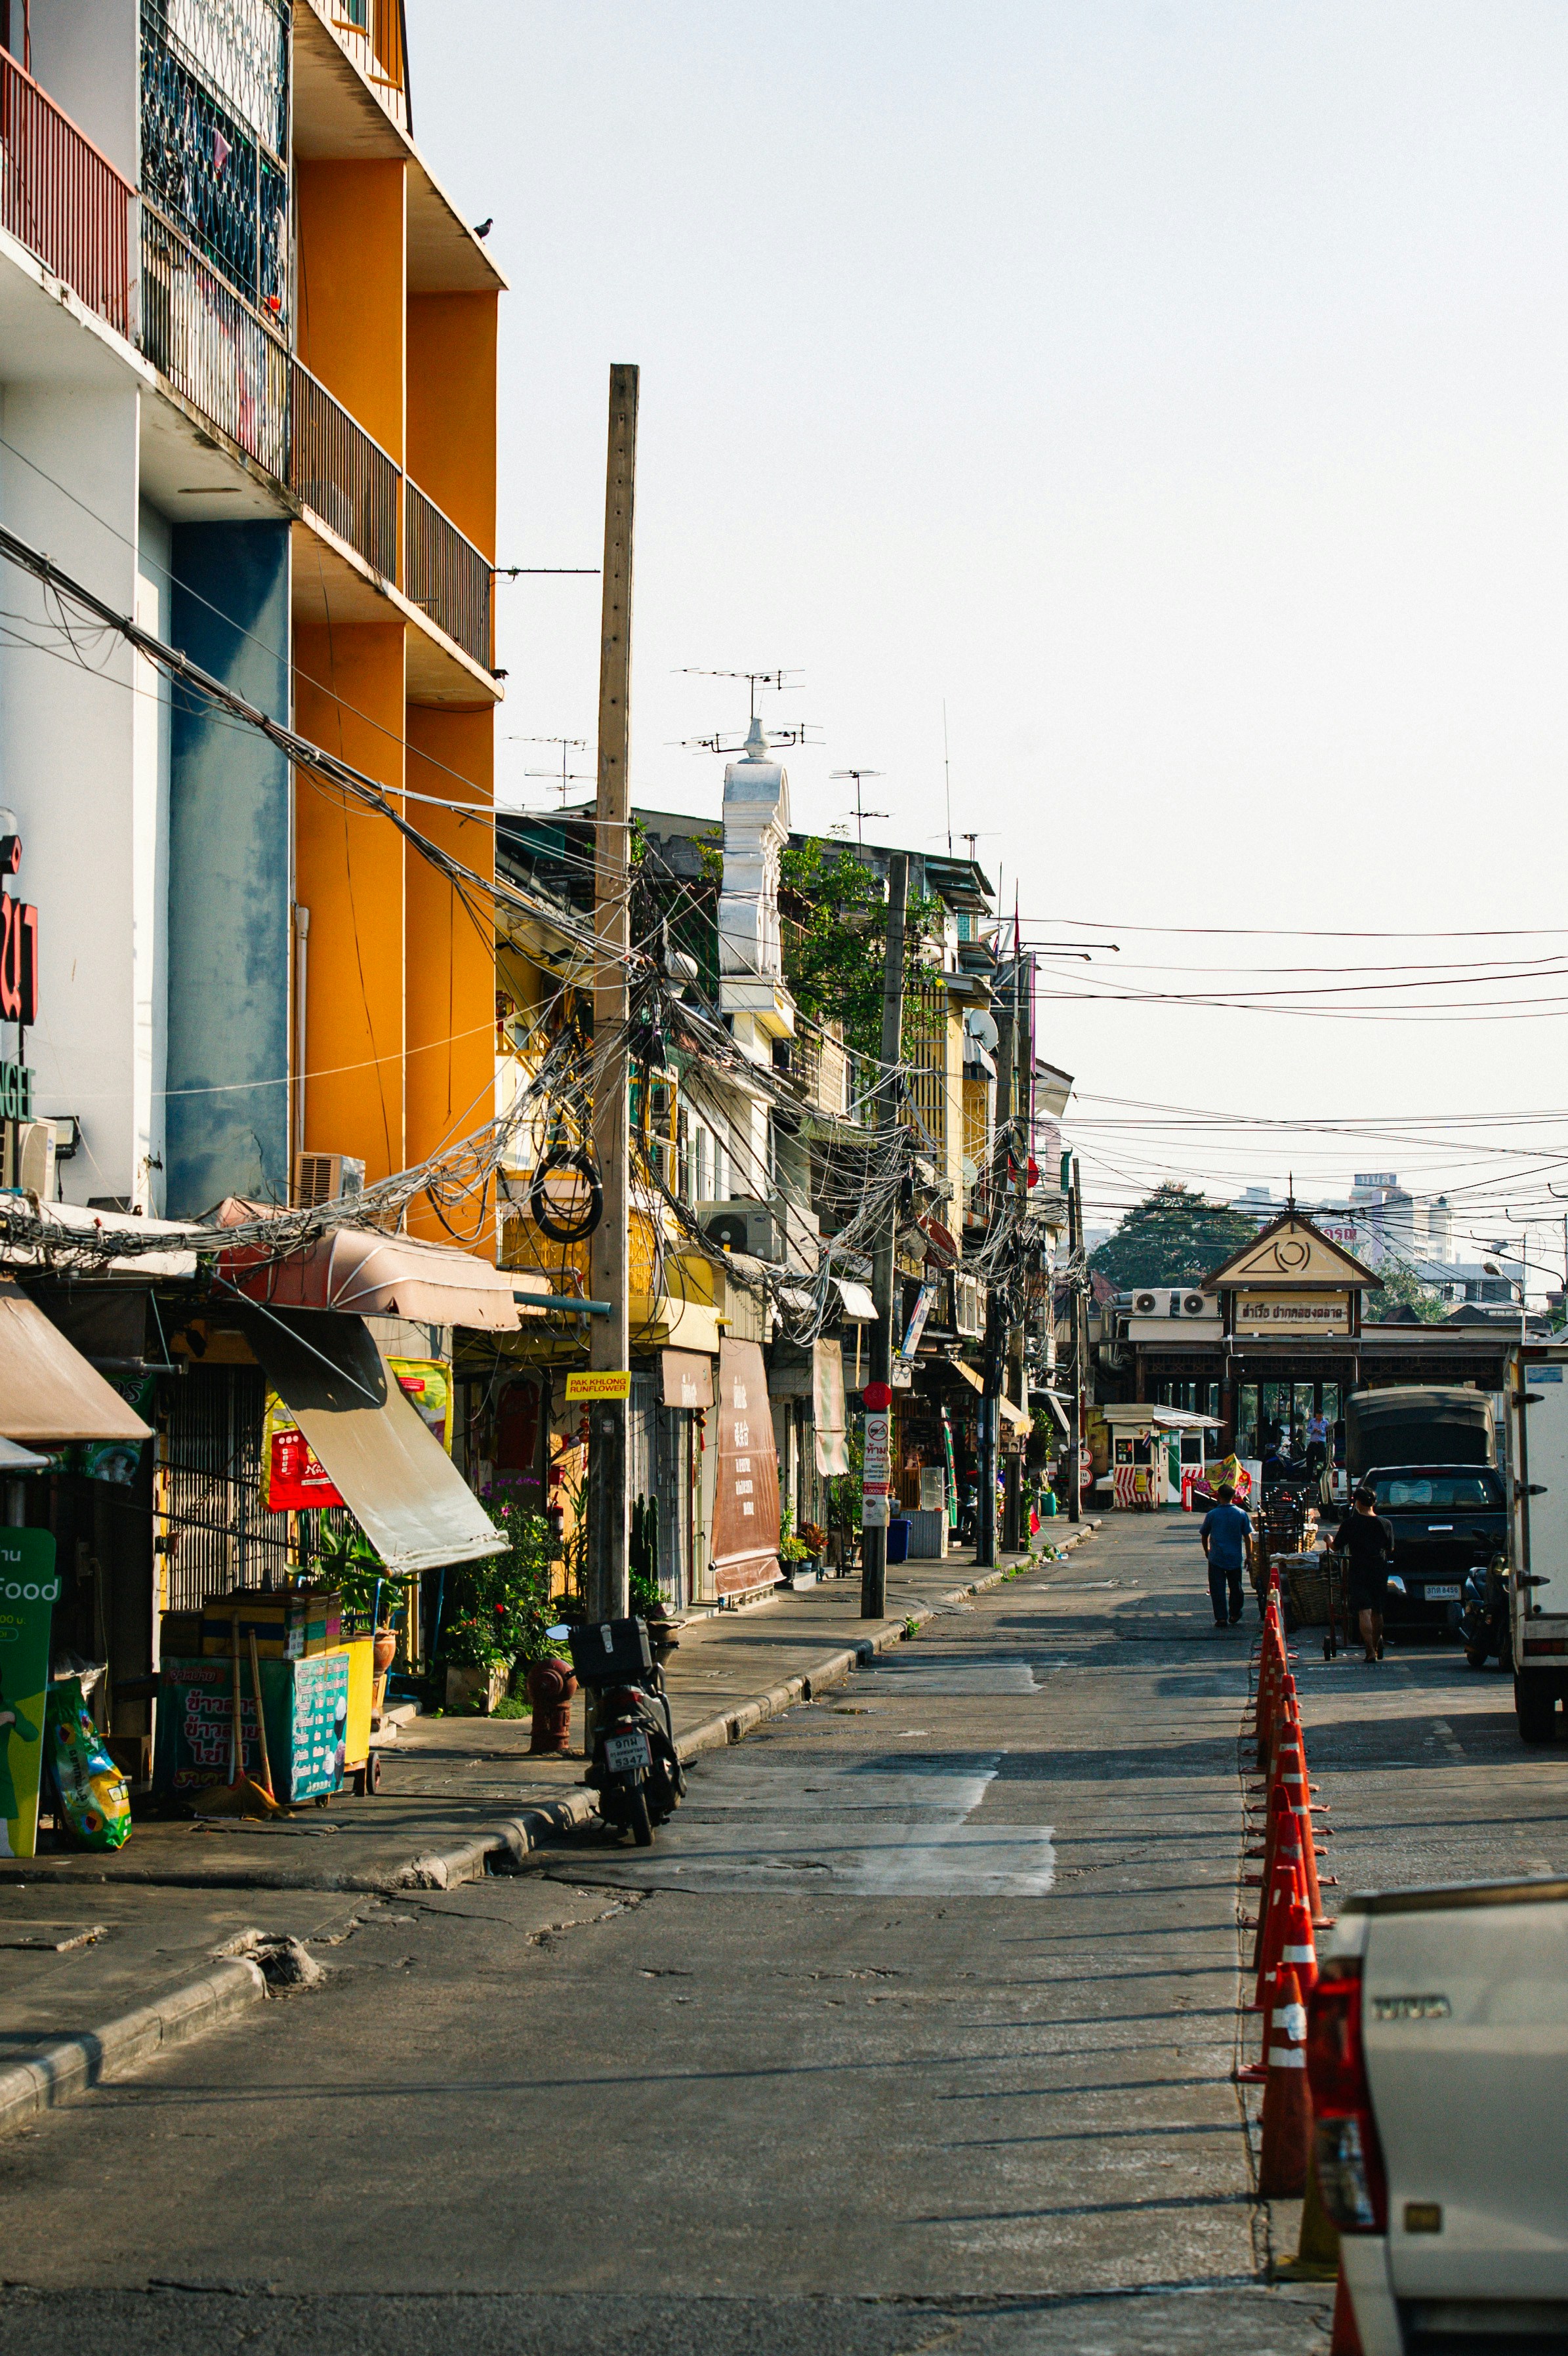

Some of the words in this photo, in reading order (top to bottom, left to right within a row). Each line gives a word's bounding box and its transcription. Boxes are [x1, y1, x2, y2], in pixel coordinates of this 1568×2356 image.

[1273, 1306, 1343, 1319] ปากคลองตลาด
[615, 1754, 643, 1766] 5347
